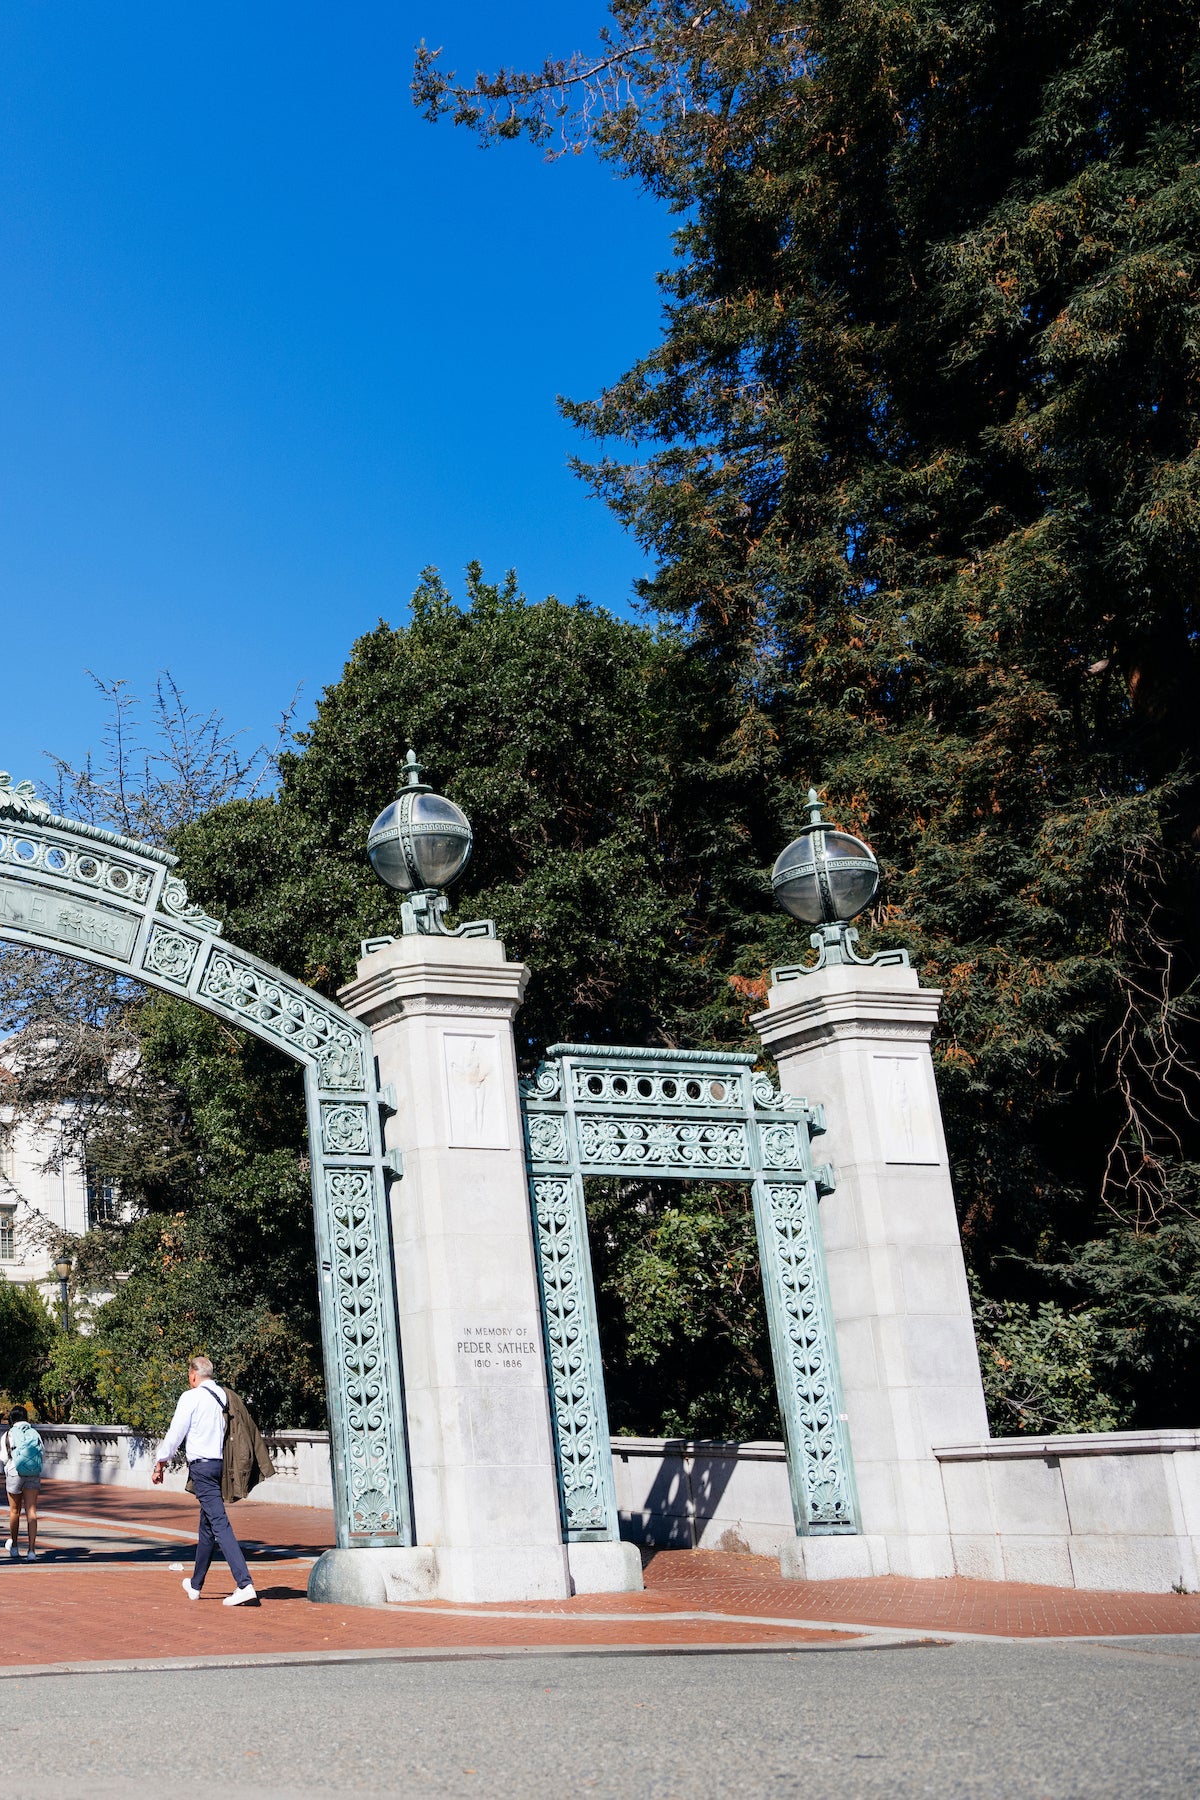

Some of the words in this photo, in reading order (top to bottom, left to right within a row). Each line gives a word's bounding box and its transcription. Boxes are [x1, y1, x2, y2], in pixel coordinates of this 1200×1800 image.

[464, 1328, 472, 1336] IN
[475, 1328, 512, 1336] MEMORY
[516, 1328, 527, 1336] OF
[457, 1342, 493, 1353] PEDER
[497, 1342, 536, 1354] SATHER
[474, 1359, 491, 1368] 1810
